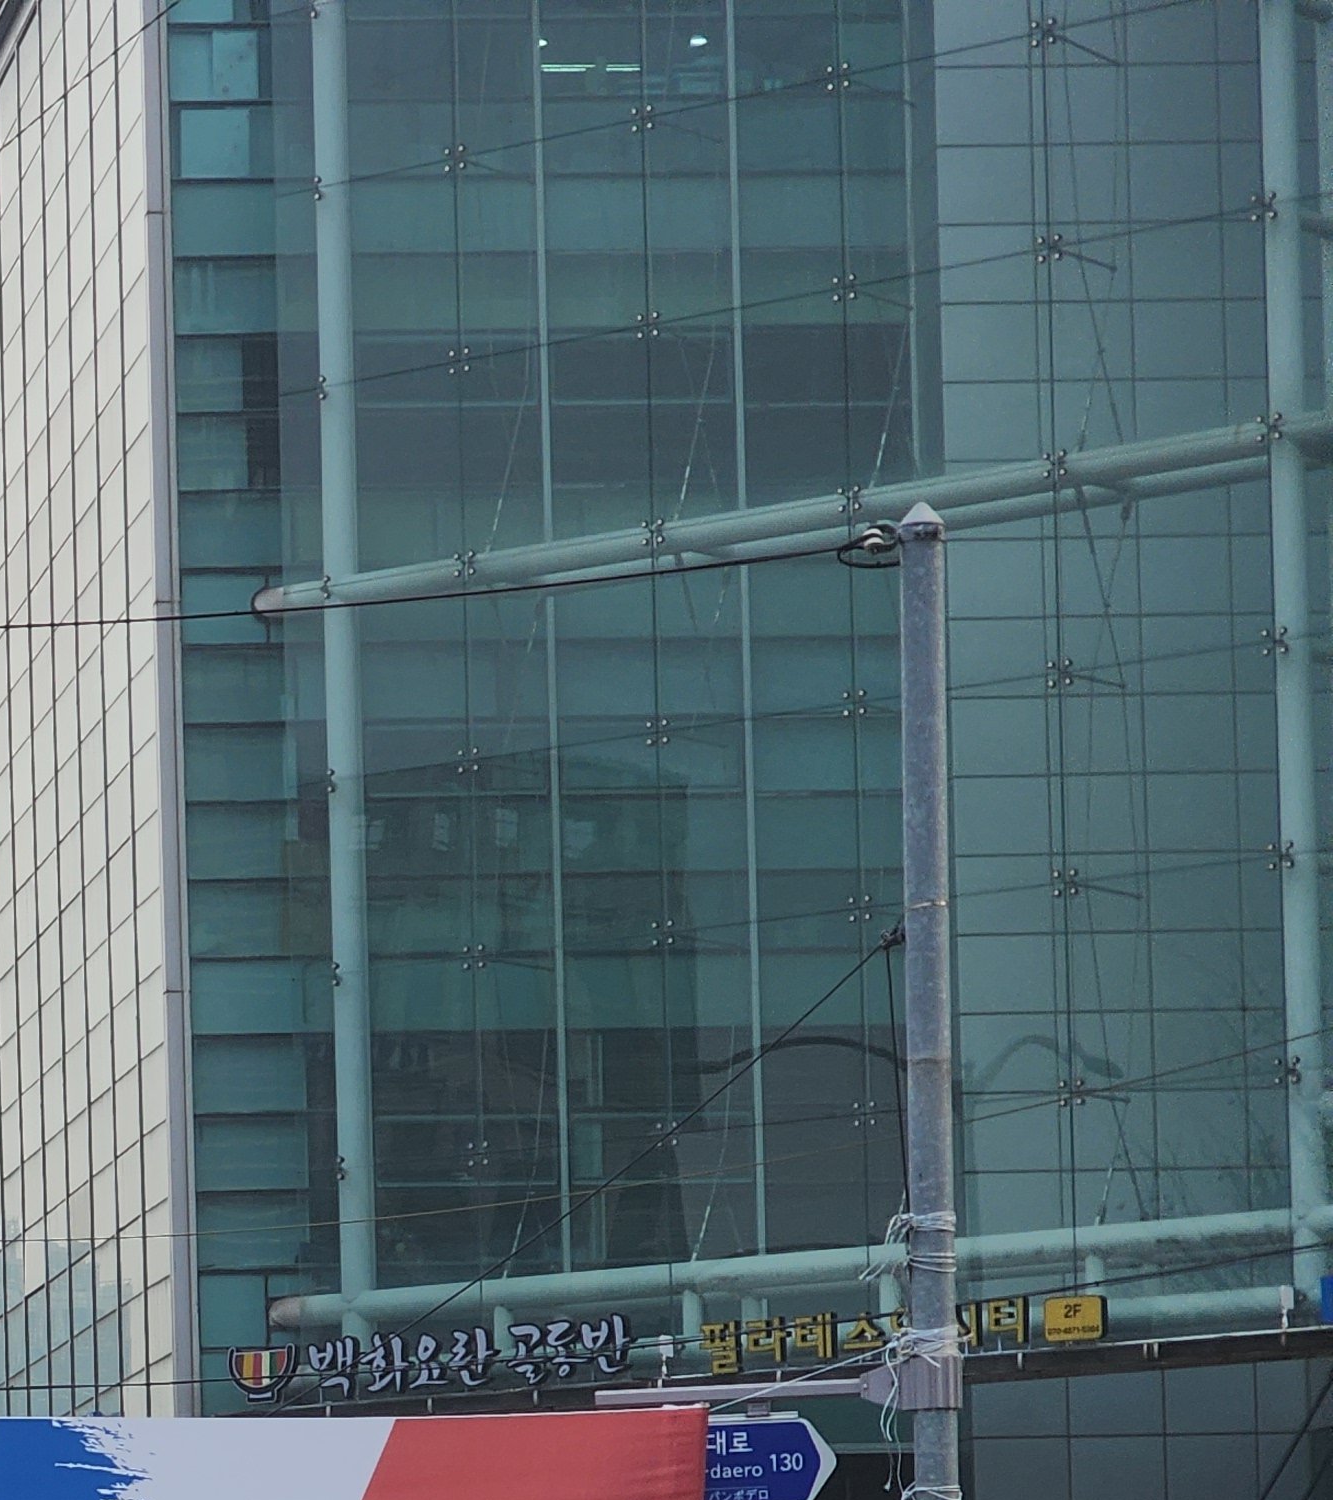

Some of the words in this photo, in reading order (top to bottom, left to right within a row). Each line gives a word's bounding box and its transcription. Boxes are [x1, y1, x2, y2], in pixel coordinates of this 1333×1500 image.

[1064, 1303, 1082, 1319] 2F
[307, 1326, 500, 1398] 백화요란
[769, 1452, 804, 1472] 130
